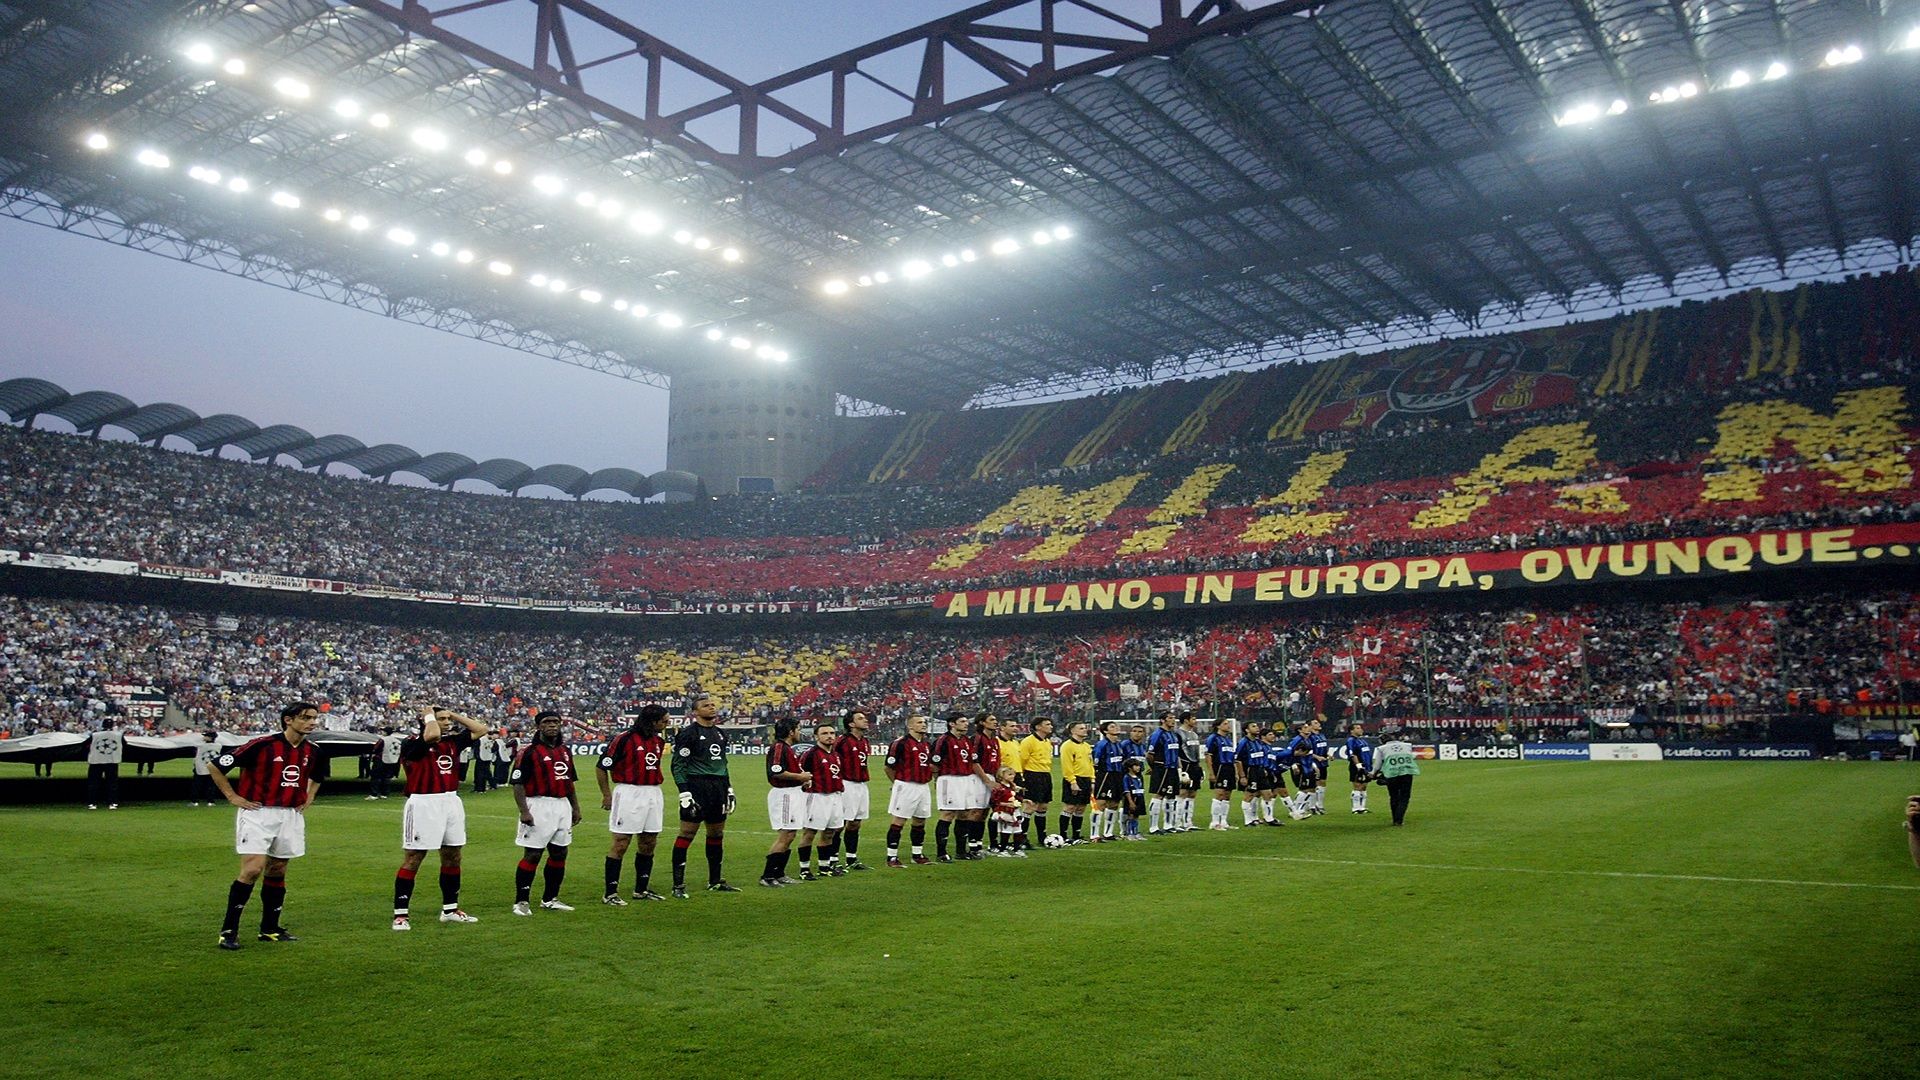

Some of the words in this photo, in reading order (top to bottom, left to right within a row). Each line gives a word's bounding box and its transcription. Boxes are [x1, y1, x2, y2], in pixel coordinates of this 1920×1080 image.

[945, 593, 969, 617] A
[983, 580, 1165, 617] MILANO,
[1183, 575, 1234, 604] IN
[1254, 557, 1495, 601] EUROPA,
[1520, 528, 1920, 583] OVUNQUE..
[705, 602, 791, 614] TORCIDA
[1459, 745, 1519, 759] adidas
[1524, 748, 1589, 756] MOTOROLA
